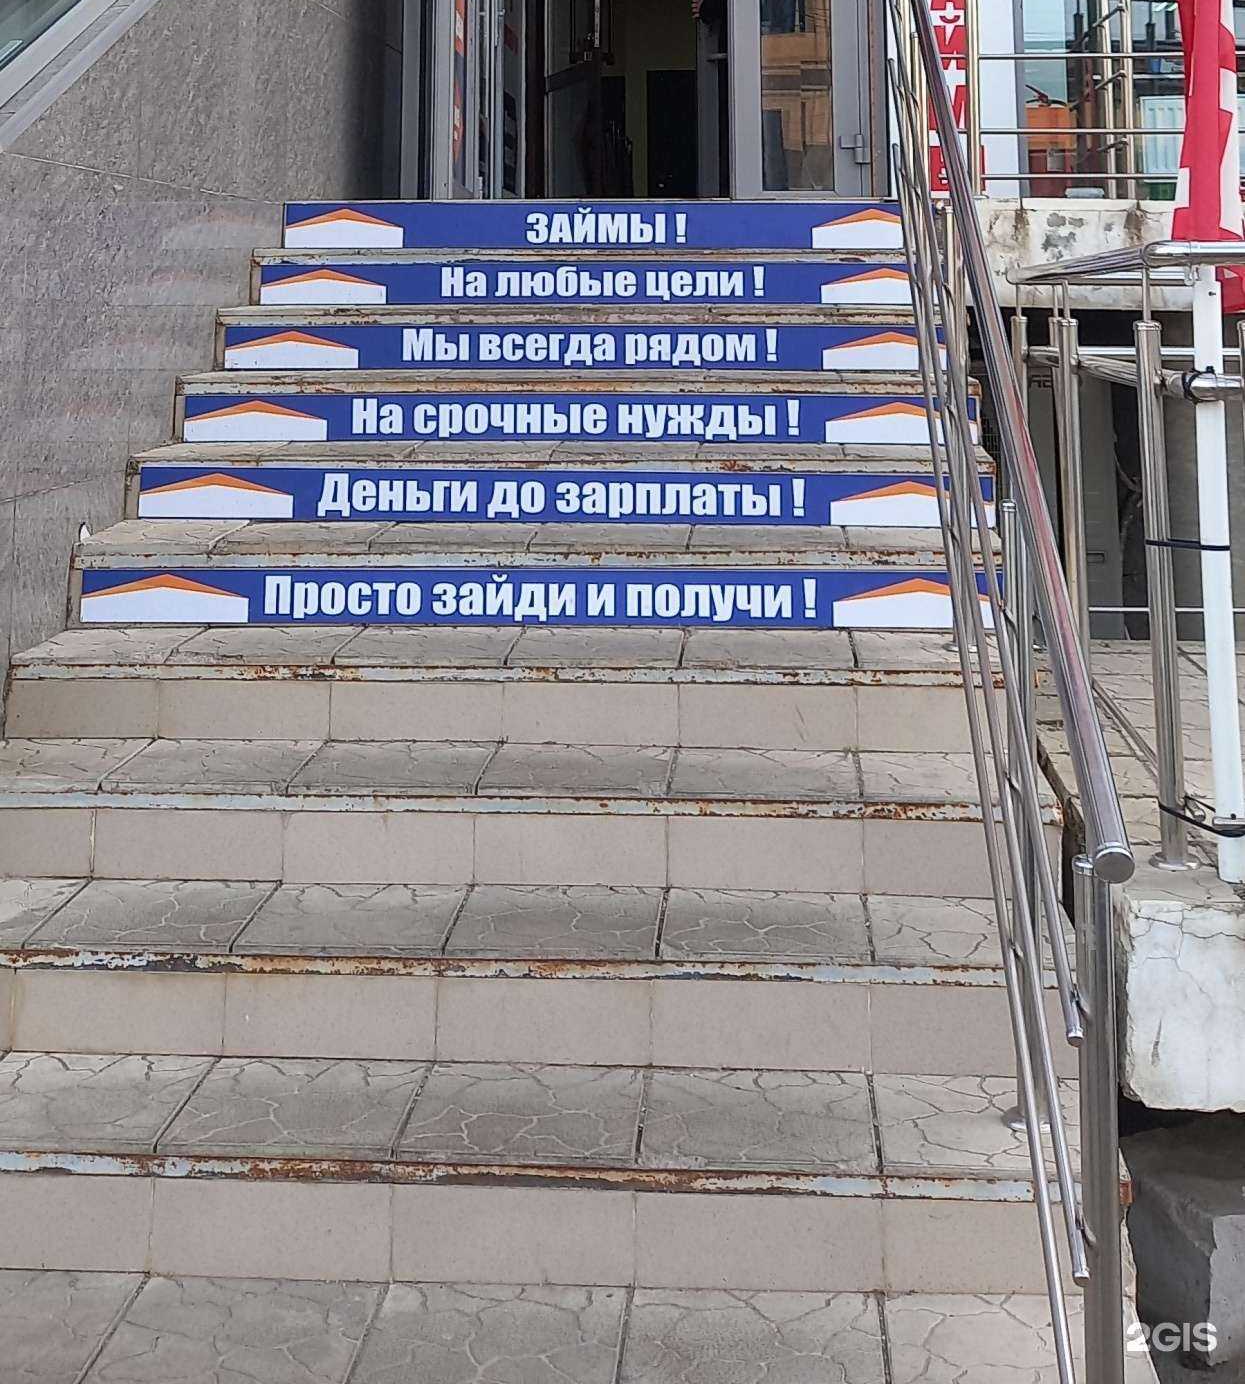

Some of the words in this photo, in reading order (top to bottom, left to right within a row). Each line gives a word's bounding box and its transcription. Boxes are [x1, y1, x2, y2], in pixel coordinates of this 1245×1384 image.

[526, 207, 666, 244] ЗАЙМЫ
[441, 266, 487, 297] На
[494, 267, 637, 297] любые
[646, 271, 744, 302] цели
[402, 329, 470, 362] Мы
[479, 333, 616, 367] всегда
[625, 333, 757, 368] рядом
[352, 398, 403, 434] На
[413, 403, 607, 438] срочные
[618, 404, 776, 443] нужды
[316, 473, 478, 520] Деньги
[487, 481, 545, 521] до
[555, 480, 784, 520] зарплаты
[264, 575, 421, 619] Просто
[432, 574, 576, 624] зайди
[587, 583, 615, 617] и
[626, 583, 792, 623] получи
